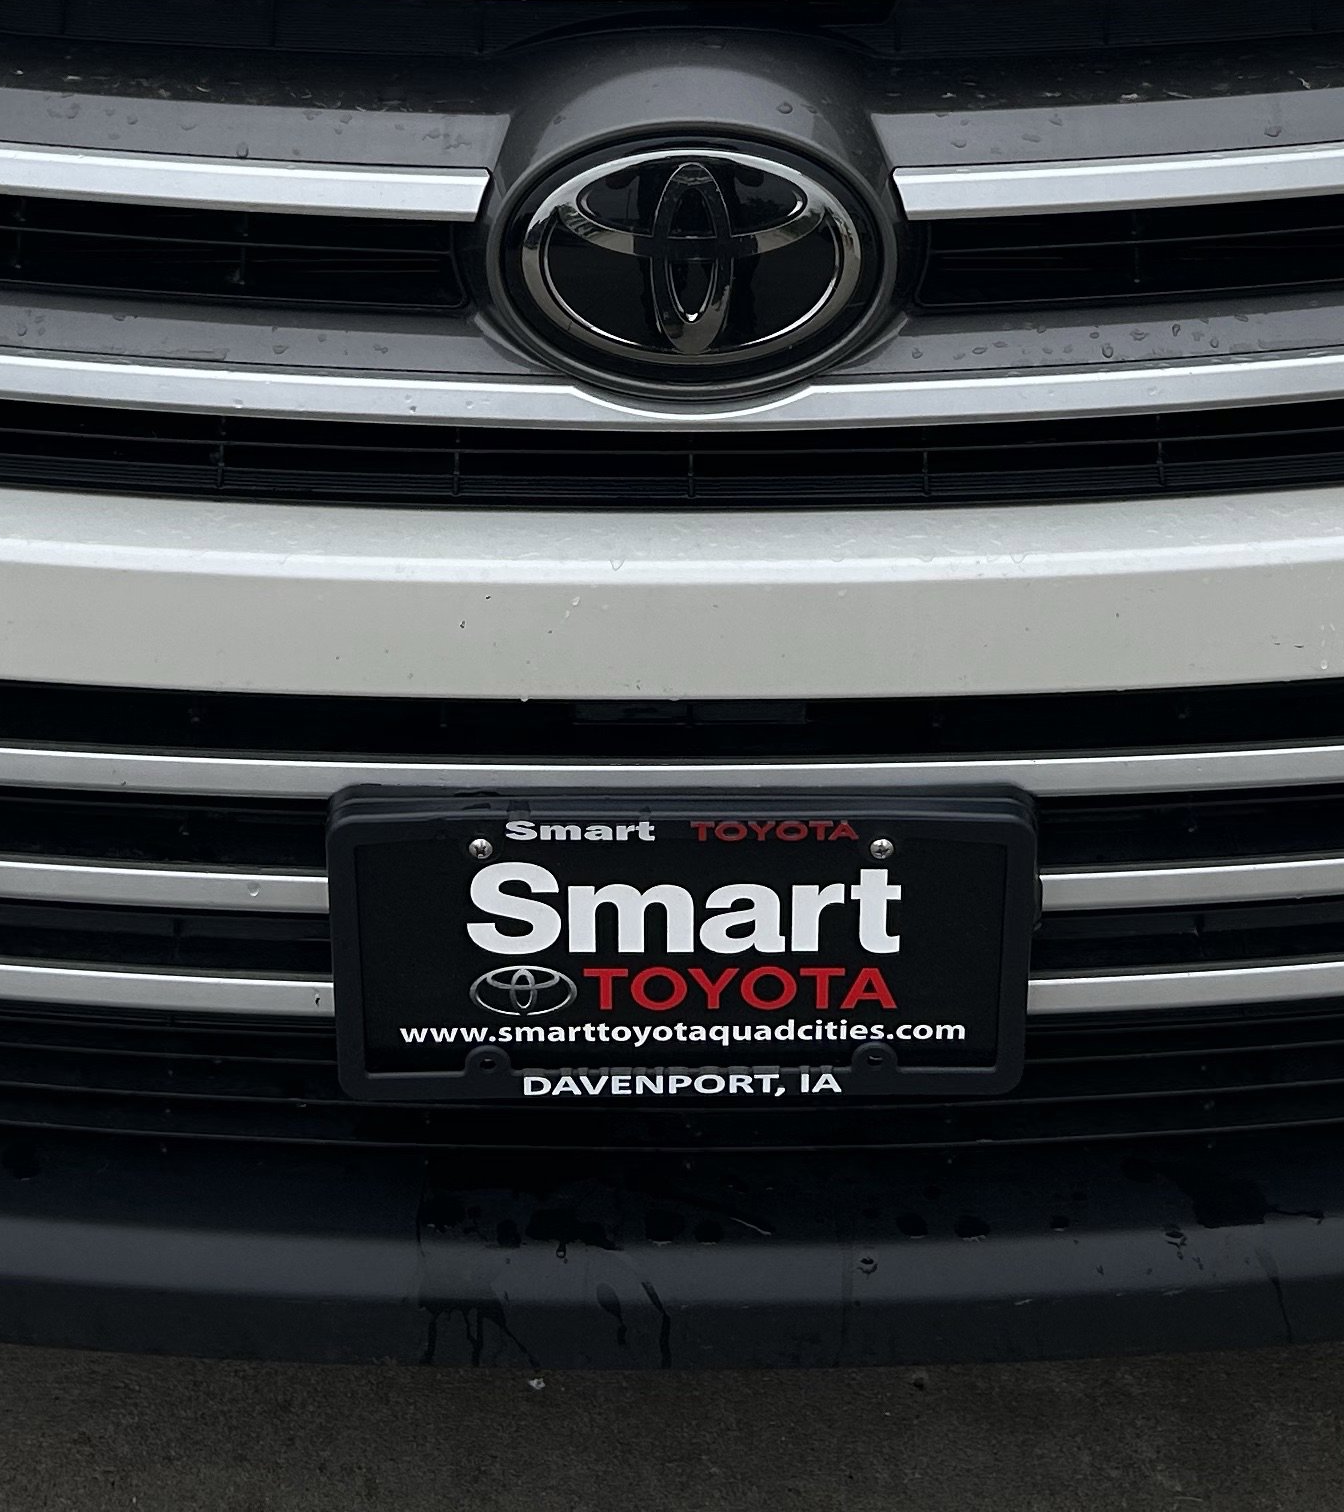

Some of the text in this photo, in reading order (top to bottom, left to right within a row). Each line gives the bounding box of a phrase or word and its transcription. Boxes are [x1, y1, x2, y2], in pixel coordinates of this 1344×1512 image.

[505, 820, 860, 842] Smart TOYOTA
[466, 861, 902, 955] Smart
[583, 966, 897, 1011] TOYOTA
[399, 1018, 967, 1048] www.smarttoyotaquadcities.com
[522, 1073, 843, 1097] DAVENPORT, IA
